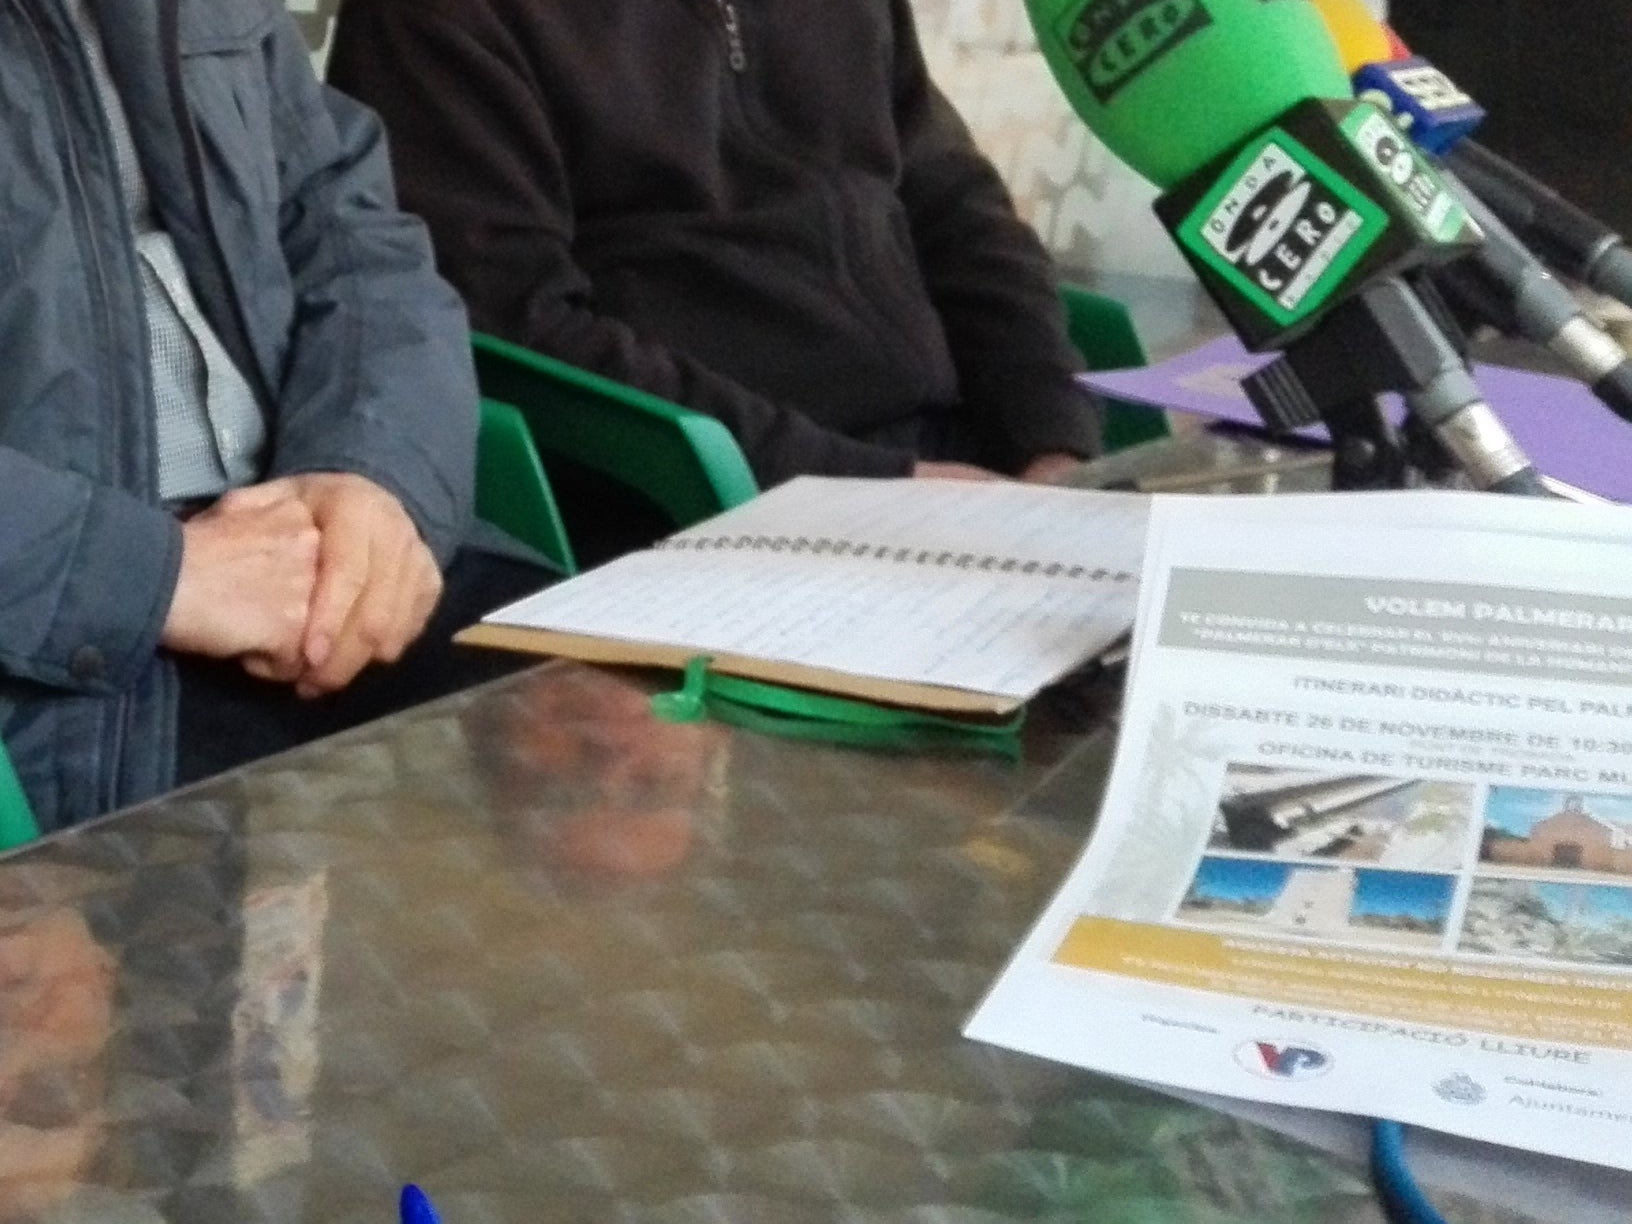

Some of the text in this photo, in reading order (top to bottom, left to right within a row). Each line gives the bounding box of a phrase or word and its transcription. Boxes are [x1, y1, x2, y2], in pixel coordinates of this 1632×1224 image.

[1257, 200, 1337, 291] CERO
[1364, 594, 1466, 620] VOLEM
[1294, 675, 1407, 701] ITINERARI
[1527, 694, 1572, 714] PEL
[1184, 700, 1298, 726] DISSABTE
[1339, 715, 1371, 735] DE
[1378, 721, 1519, 745] NOVEMBRE
[1526, 730, 1560, 750] DE
[1257, 740, 1355, 764] OFICINA
[1360, 747, 1394, 767] DE
[1404, 752, 1512, 776] TURISME
[1519, 762, 1588, 783] PARC
